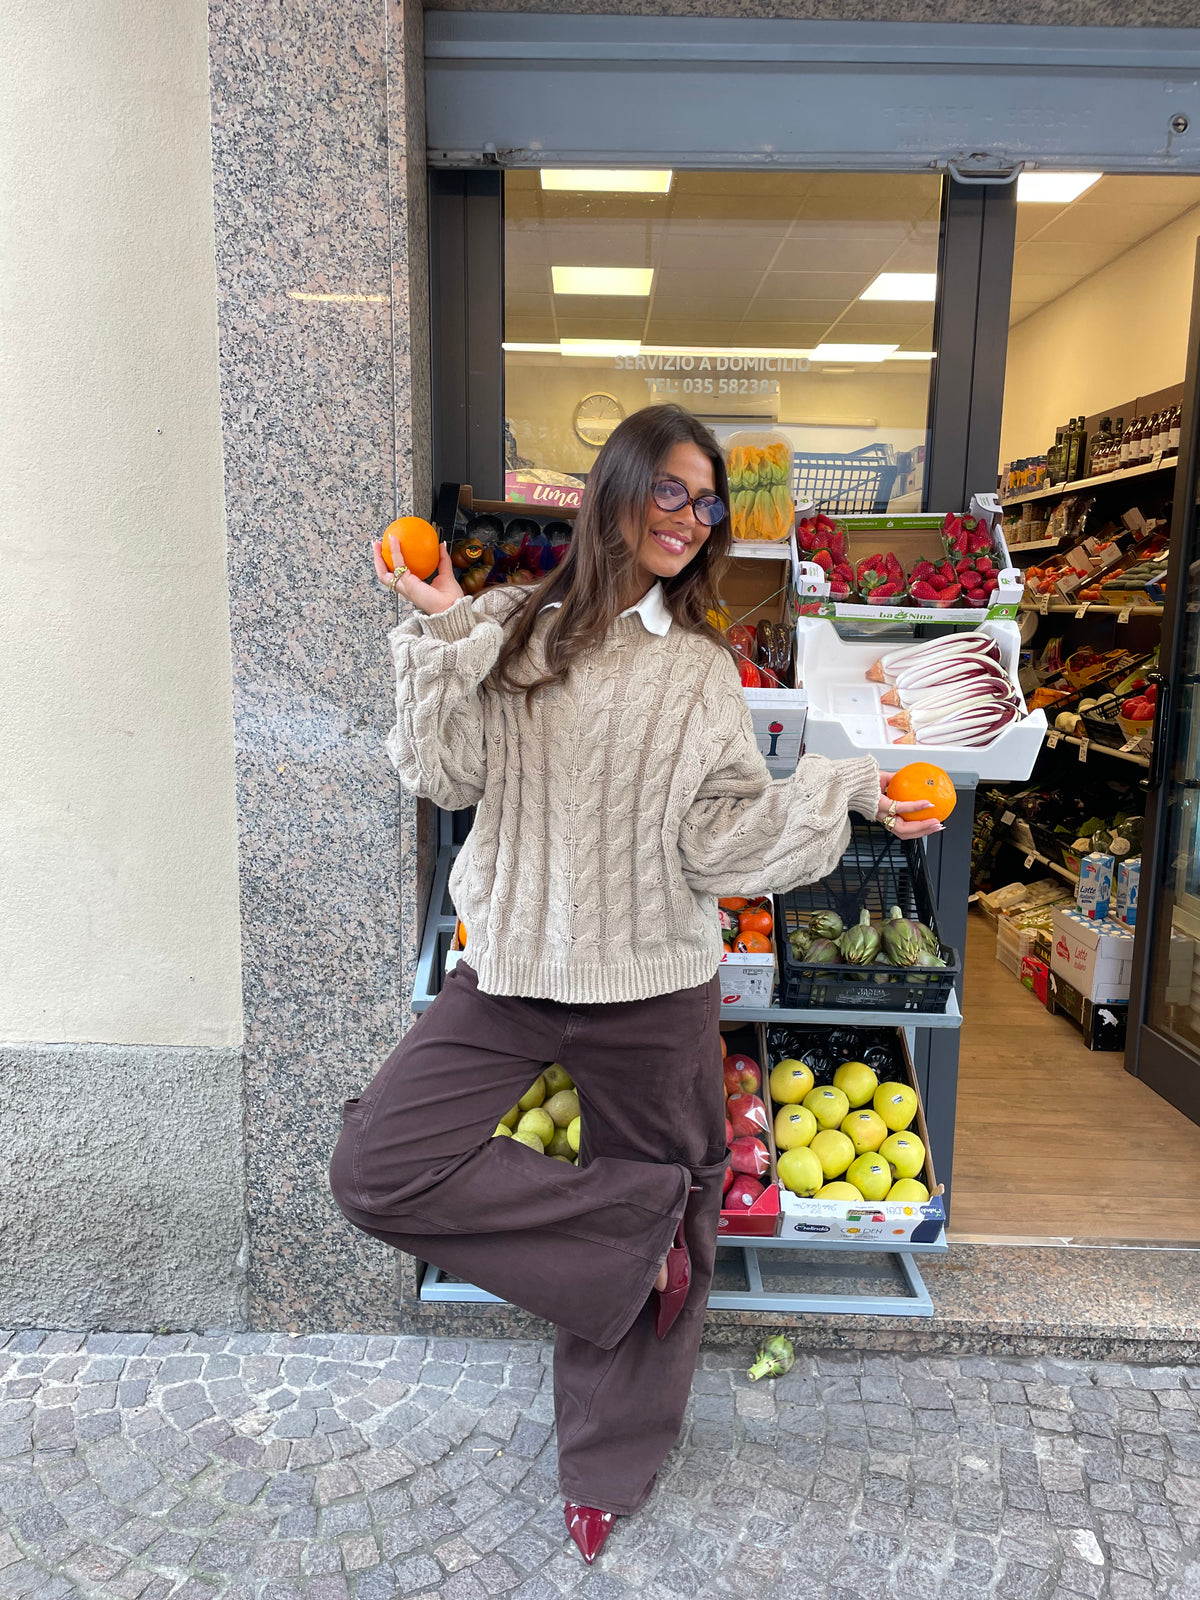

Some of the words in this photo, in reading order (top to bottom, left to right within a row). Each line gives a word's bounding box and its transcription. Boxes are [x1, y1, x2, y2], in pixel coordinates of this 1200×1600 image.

[614, 355, 695, 370] SERVIZIO
[699, 357, 712, 371] A
[716, 357, 811, 372] DOMICILIO
[644, 377, 679, 393] TEL:
[683, 378, 713, 393] 035
[718, 379, 779, 395] 582381
[1080, 886, 1097, 895] Latte
[1074, 946, 1088, 961] Latte
